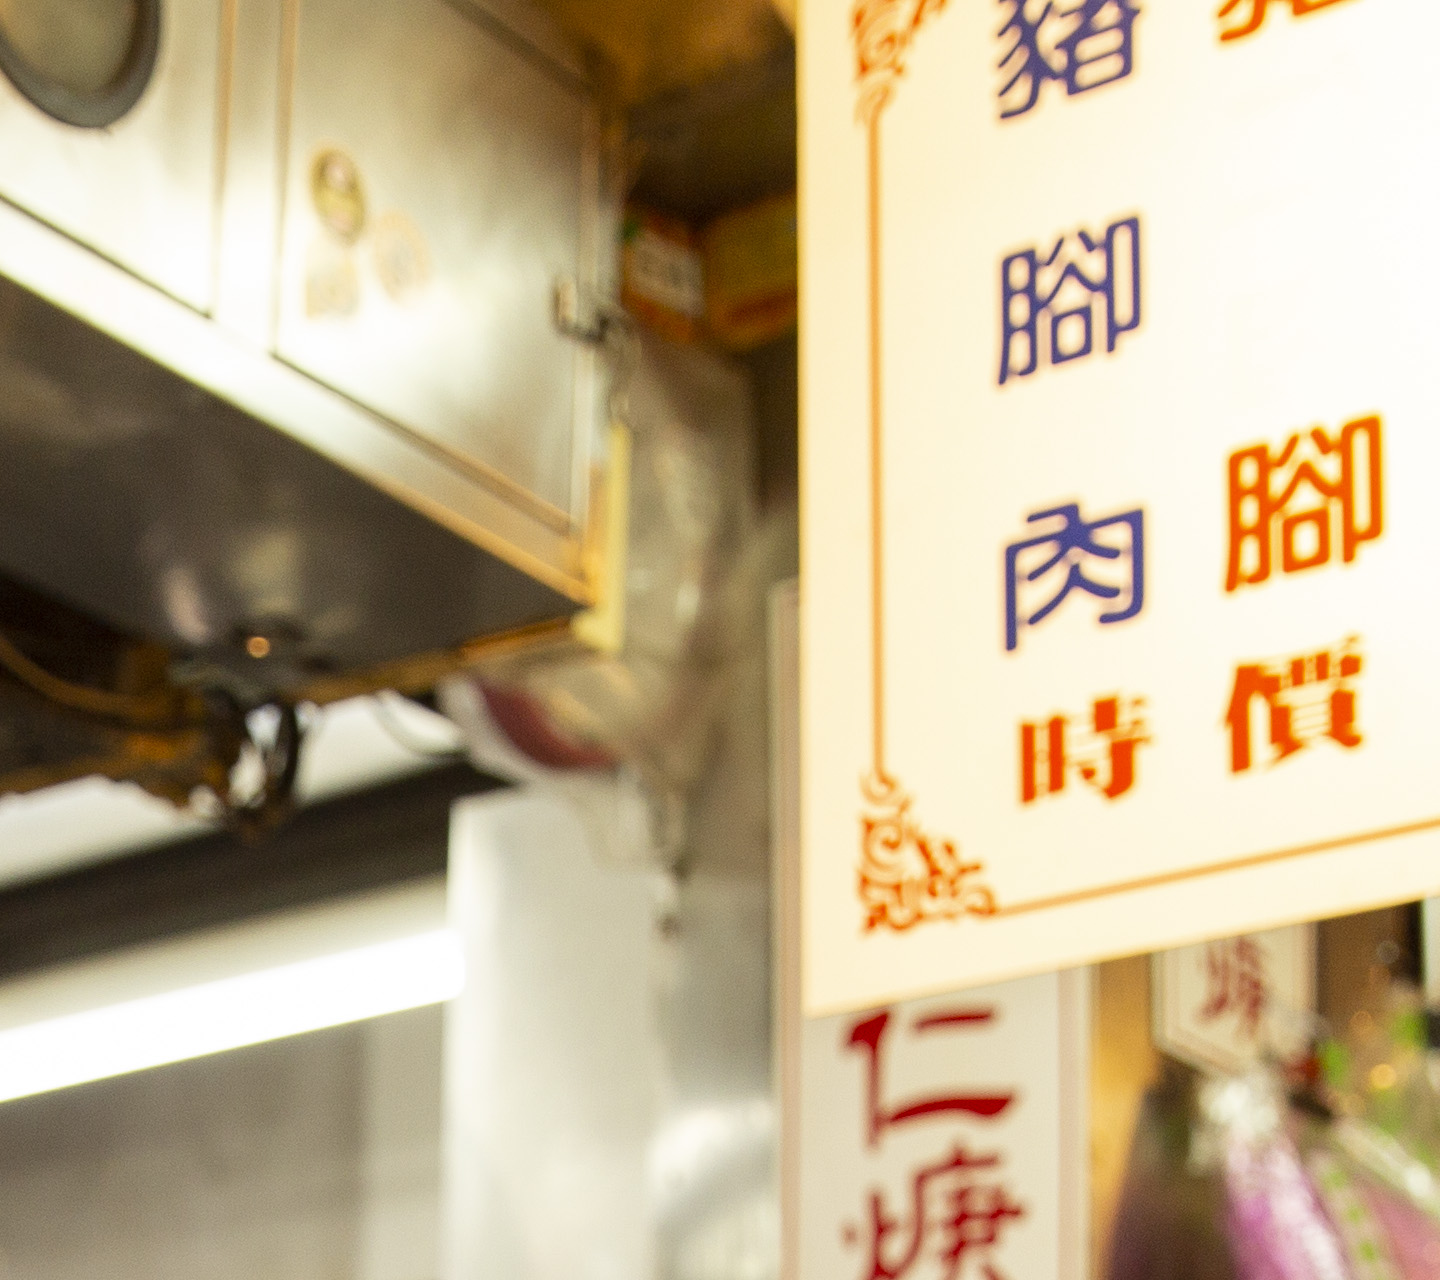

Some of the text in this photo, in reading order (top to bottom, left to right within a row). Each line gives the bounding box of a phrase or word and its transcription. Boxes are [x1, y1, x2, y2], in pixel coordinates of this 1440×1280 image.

[997, 0, 1144, 653] 豬腳肉
[1218, 0, 1384, 593] 腳
[1018, 634, 1366, 804] 時價
